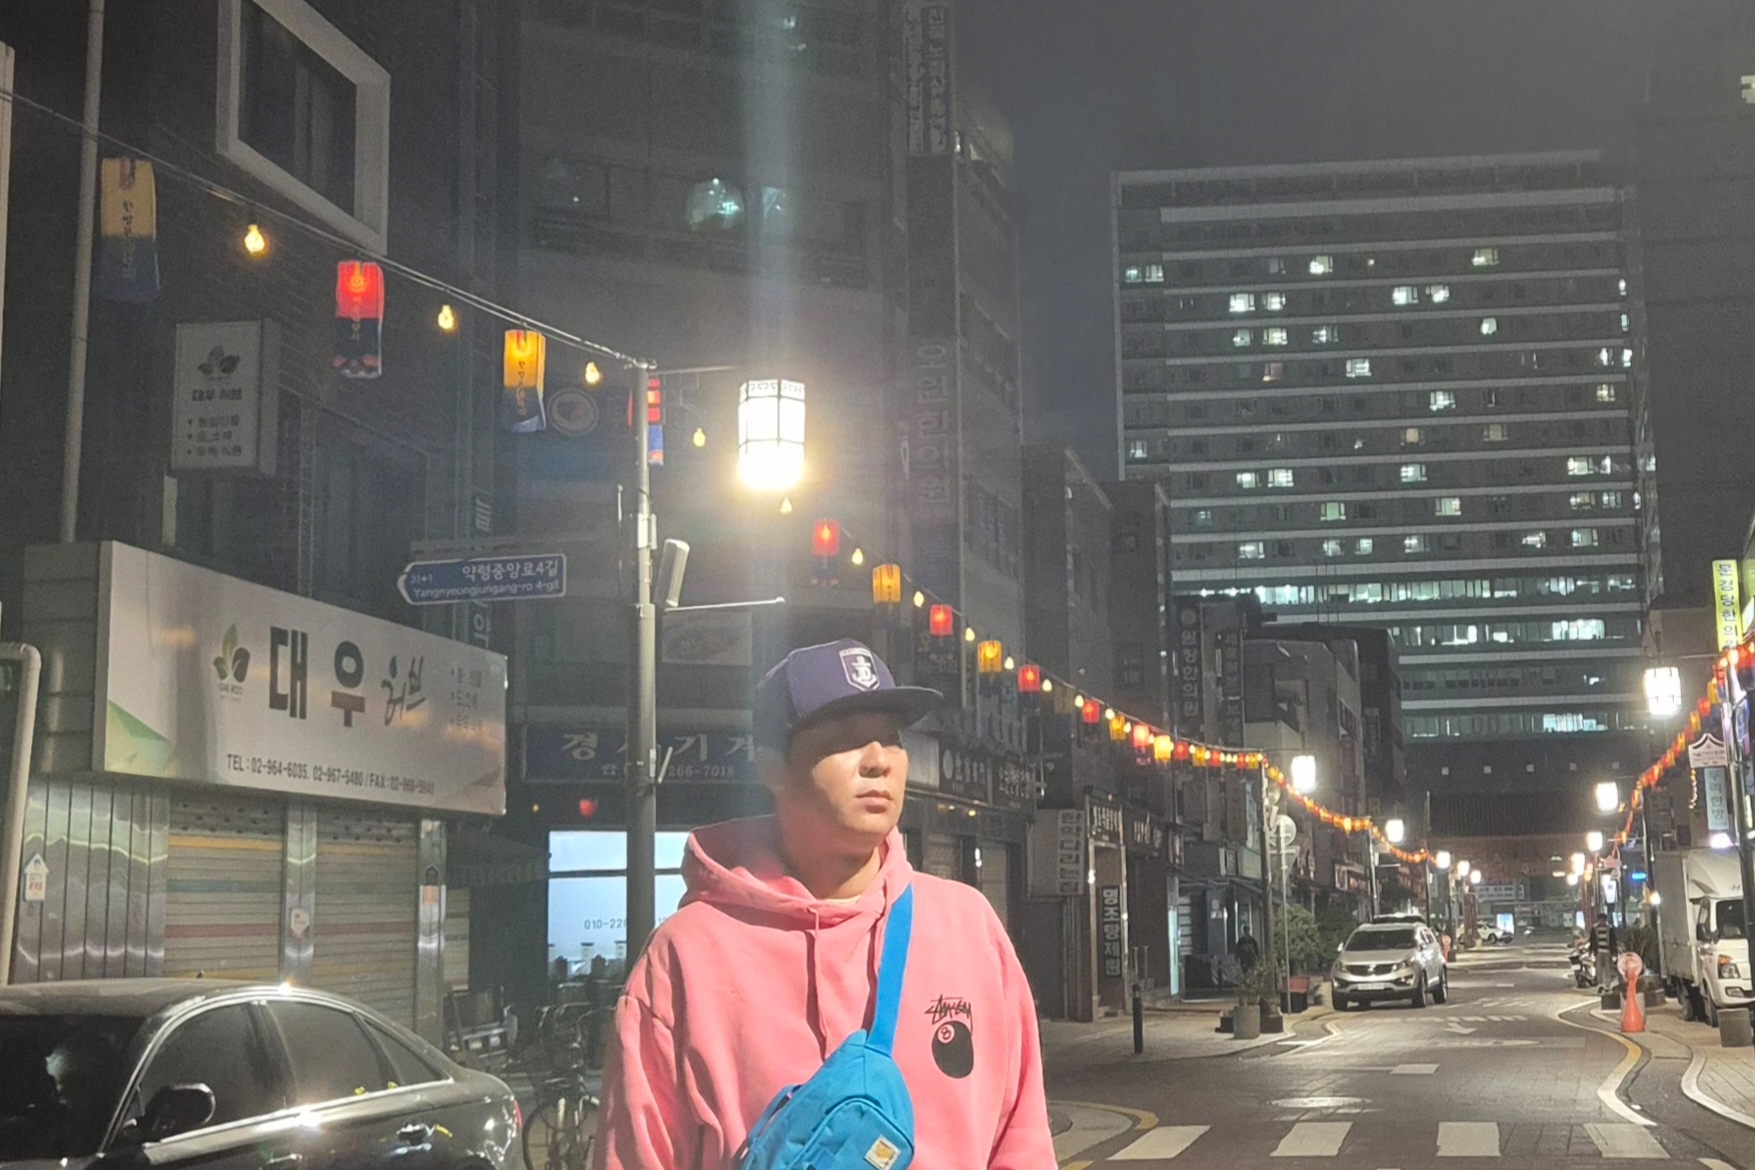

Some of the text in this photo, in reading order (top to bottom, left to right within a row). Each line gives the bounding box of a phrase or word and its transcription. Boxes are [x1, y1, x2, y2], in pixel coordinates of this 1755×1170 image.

[462, 559, 559, 582] 약령중앙로4길
[413, 583, 533, 598] Yangnyeongjungang-ro
[269, 625, 366, 727] 대우
[940, 1026, 952, 1040] 8
